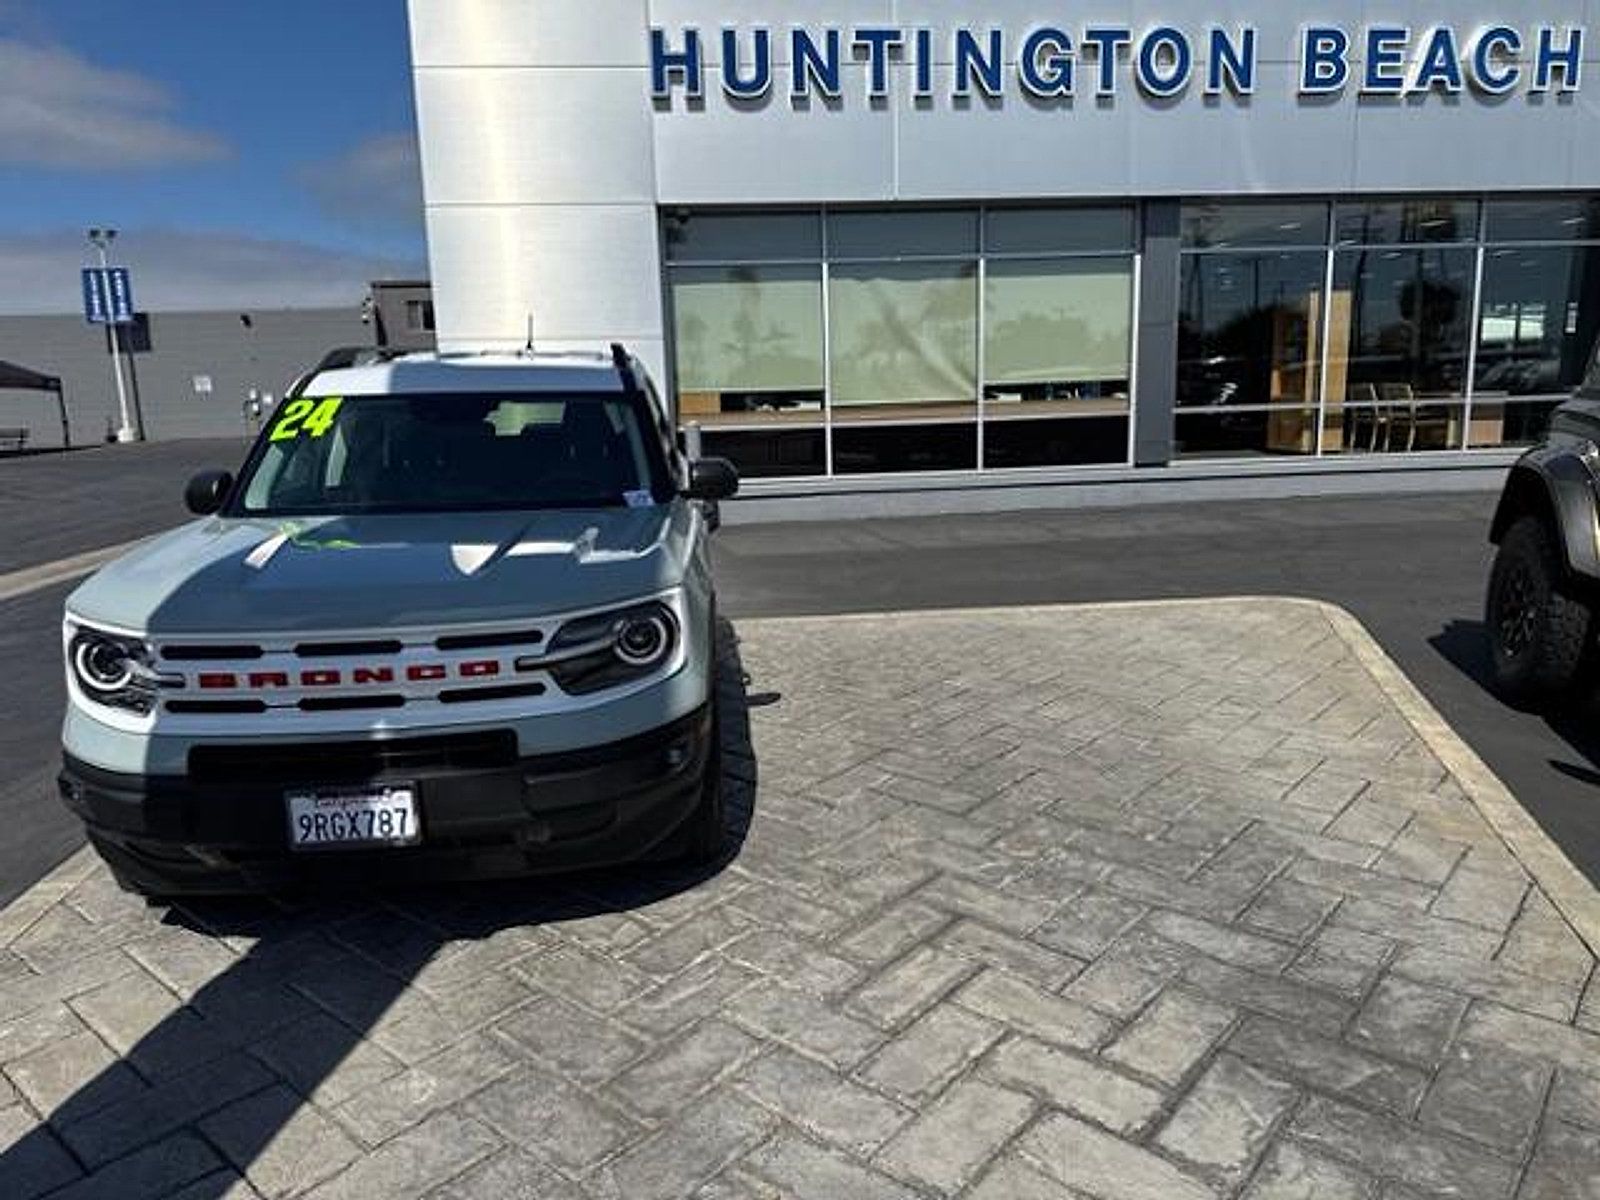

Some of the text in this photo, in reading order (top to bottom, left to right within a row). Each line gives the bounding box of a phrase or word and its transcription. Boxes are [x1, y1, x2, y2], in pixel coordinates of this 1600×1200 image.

[651, 26, 1584, 97] HUNTINGTON BEACH
[268, 396, 342, 441] 24
[199, 660, 500, 688] BRONCO
[299, 807, 407, 841] 9RGX787
